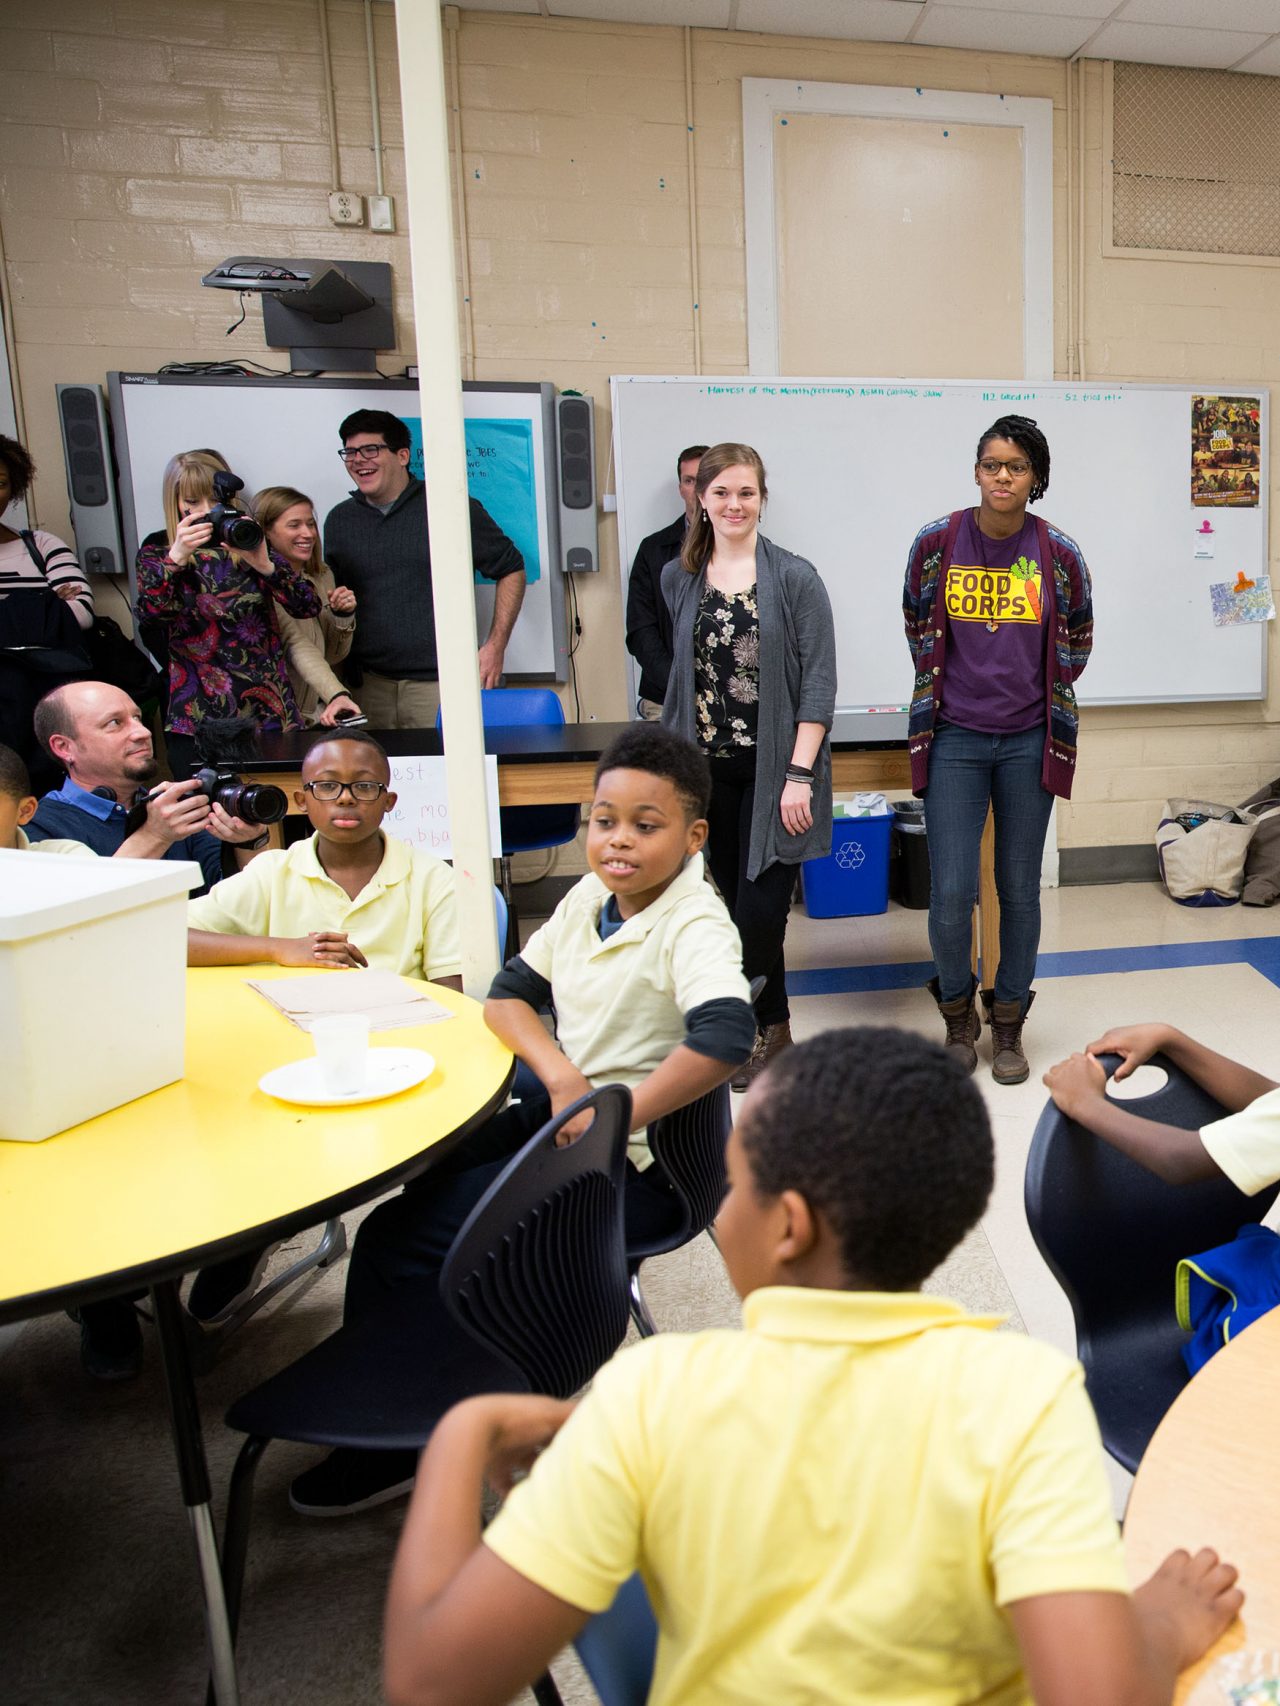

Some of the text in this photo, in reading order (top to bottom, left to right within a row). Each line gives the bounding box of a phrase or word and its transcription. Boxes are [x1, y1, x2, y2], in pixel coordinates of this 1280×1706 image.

[707, 386, 744, 394] Harvest
[749, 386, 757, 394] of
[762, 386, 777, 395] the
[1213, 430, 1227, 438] JOIN
[948, 572, 1011, 595] FOOD
[948, 594, 1026, 616] CORPS
